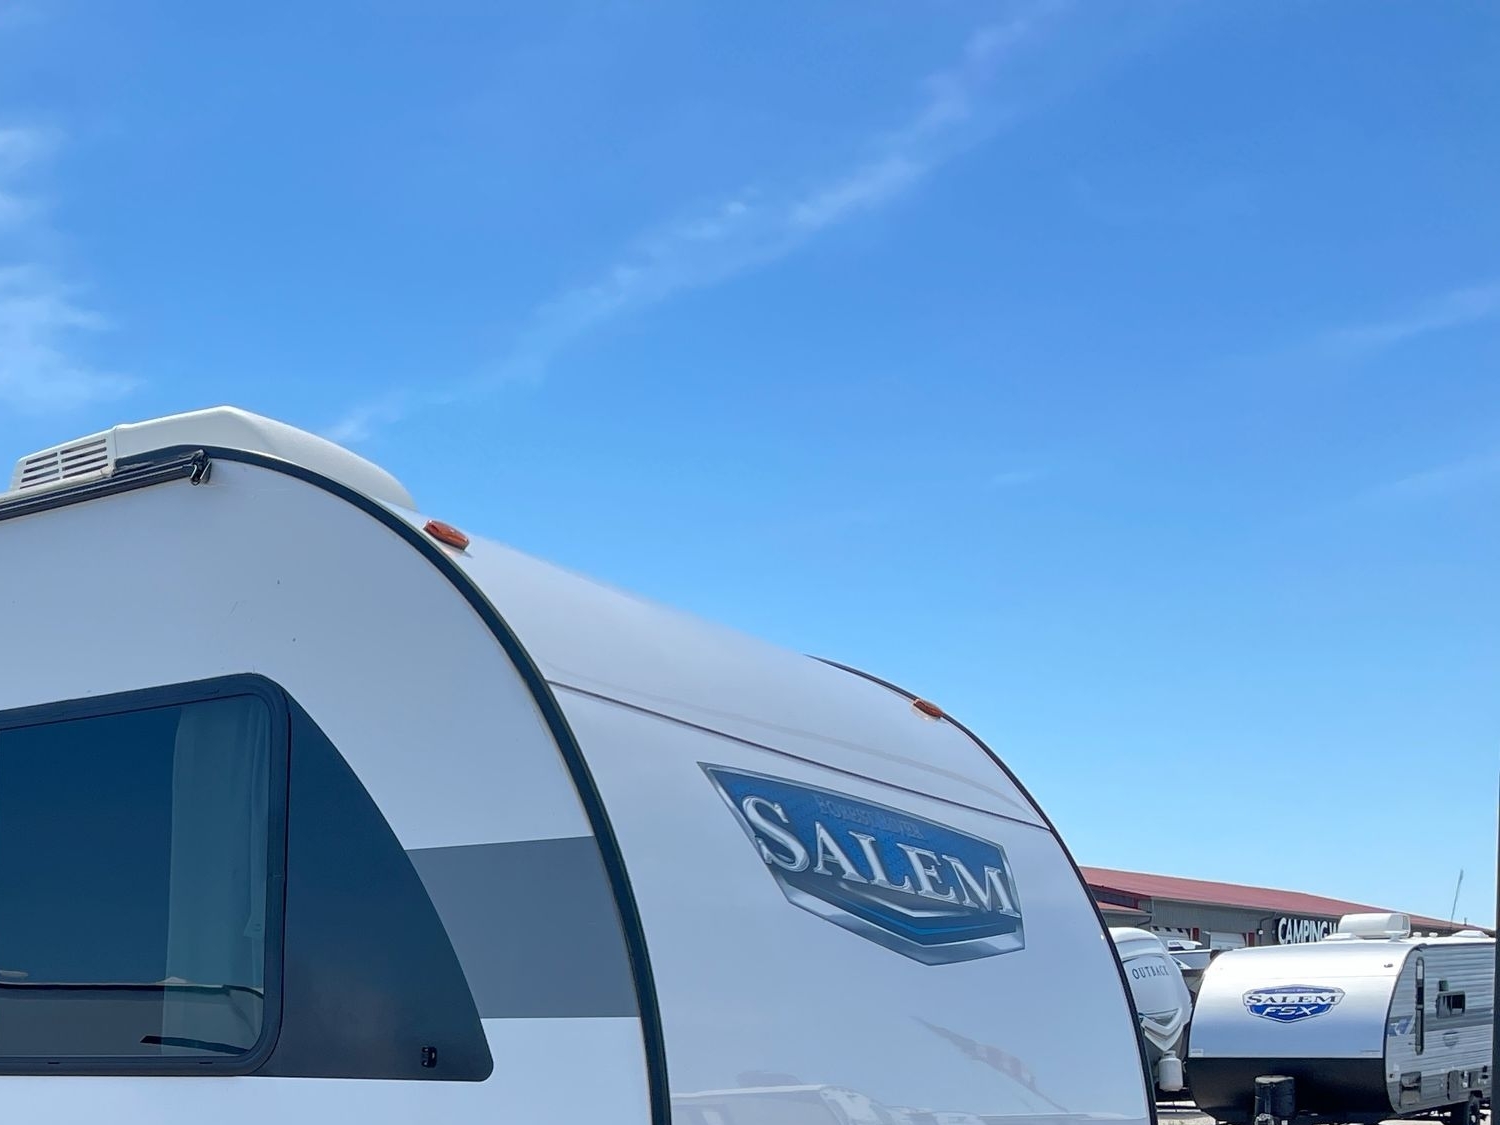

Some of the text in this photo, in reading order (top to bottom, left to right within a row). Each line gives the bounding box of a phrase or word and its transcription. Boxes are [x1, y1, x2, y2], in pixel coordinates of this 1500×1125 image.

[742, 795, 1022, 918] SALEM
[1278, 917, 1328, 945] CAMPING
[1132, 965, 1170, 979] OUTBACK
[1246, 994, 1337, 1004] SALEM
[1262, 1006, 1318, 1016] FSX
